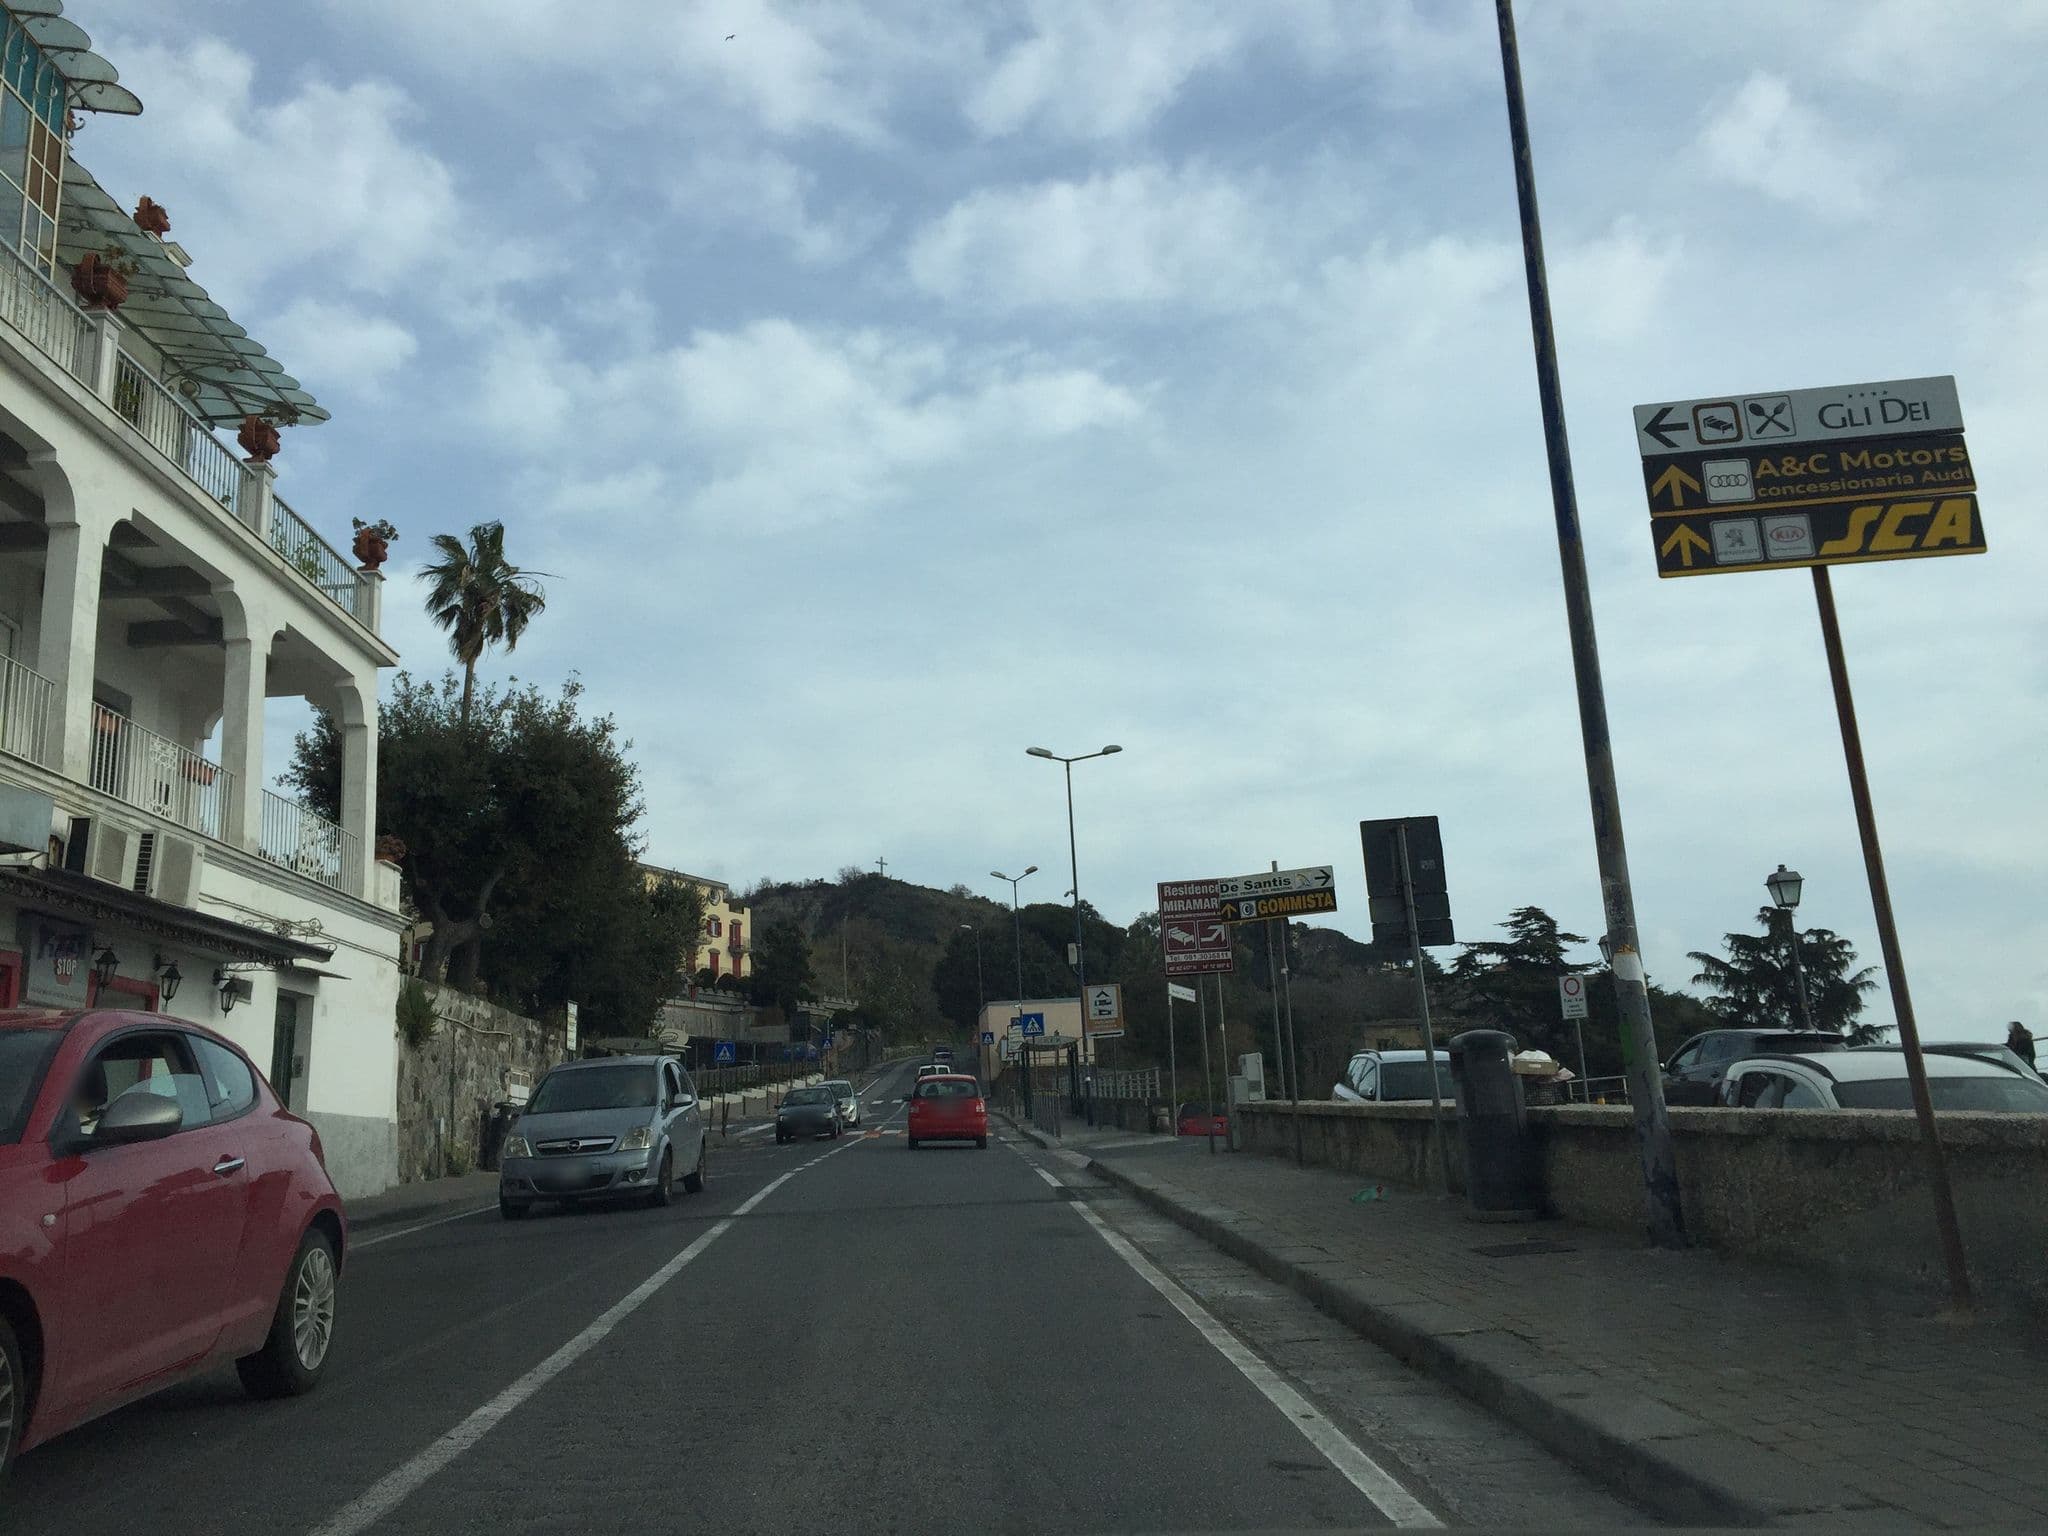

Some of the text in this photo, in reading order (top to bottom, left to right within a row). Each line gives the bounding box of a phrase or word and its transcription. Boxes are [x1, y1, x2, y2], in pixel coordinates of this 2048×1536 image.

[1755, 444, 1968, 479] A&C Motors
[1757, 467, 1971, 498] concessionaria Audi
[1775, 529, 1800, 540] KIA
[1819, 496, 1974, 556] SCA
[1220, 884, 1239, 894] De
[1243, 876, 1292, 891] Santis
[1257, 892, 1335, 915] GOMMISTA
[56, 958, 77, 976] STOP
